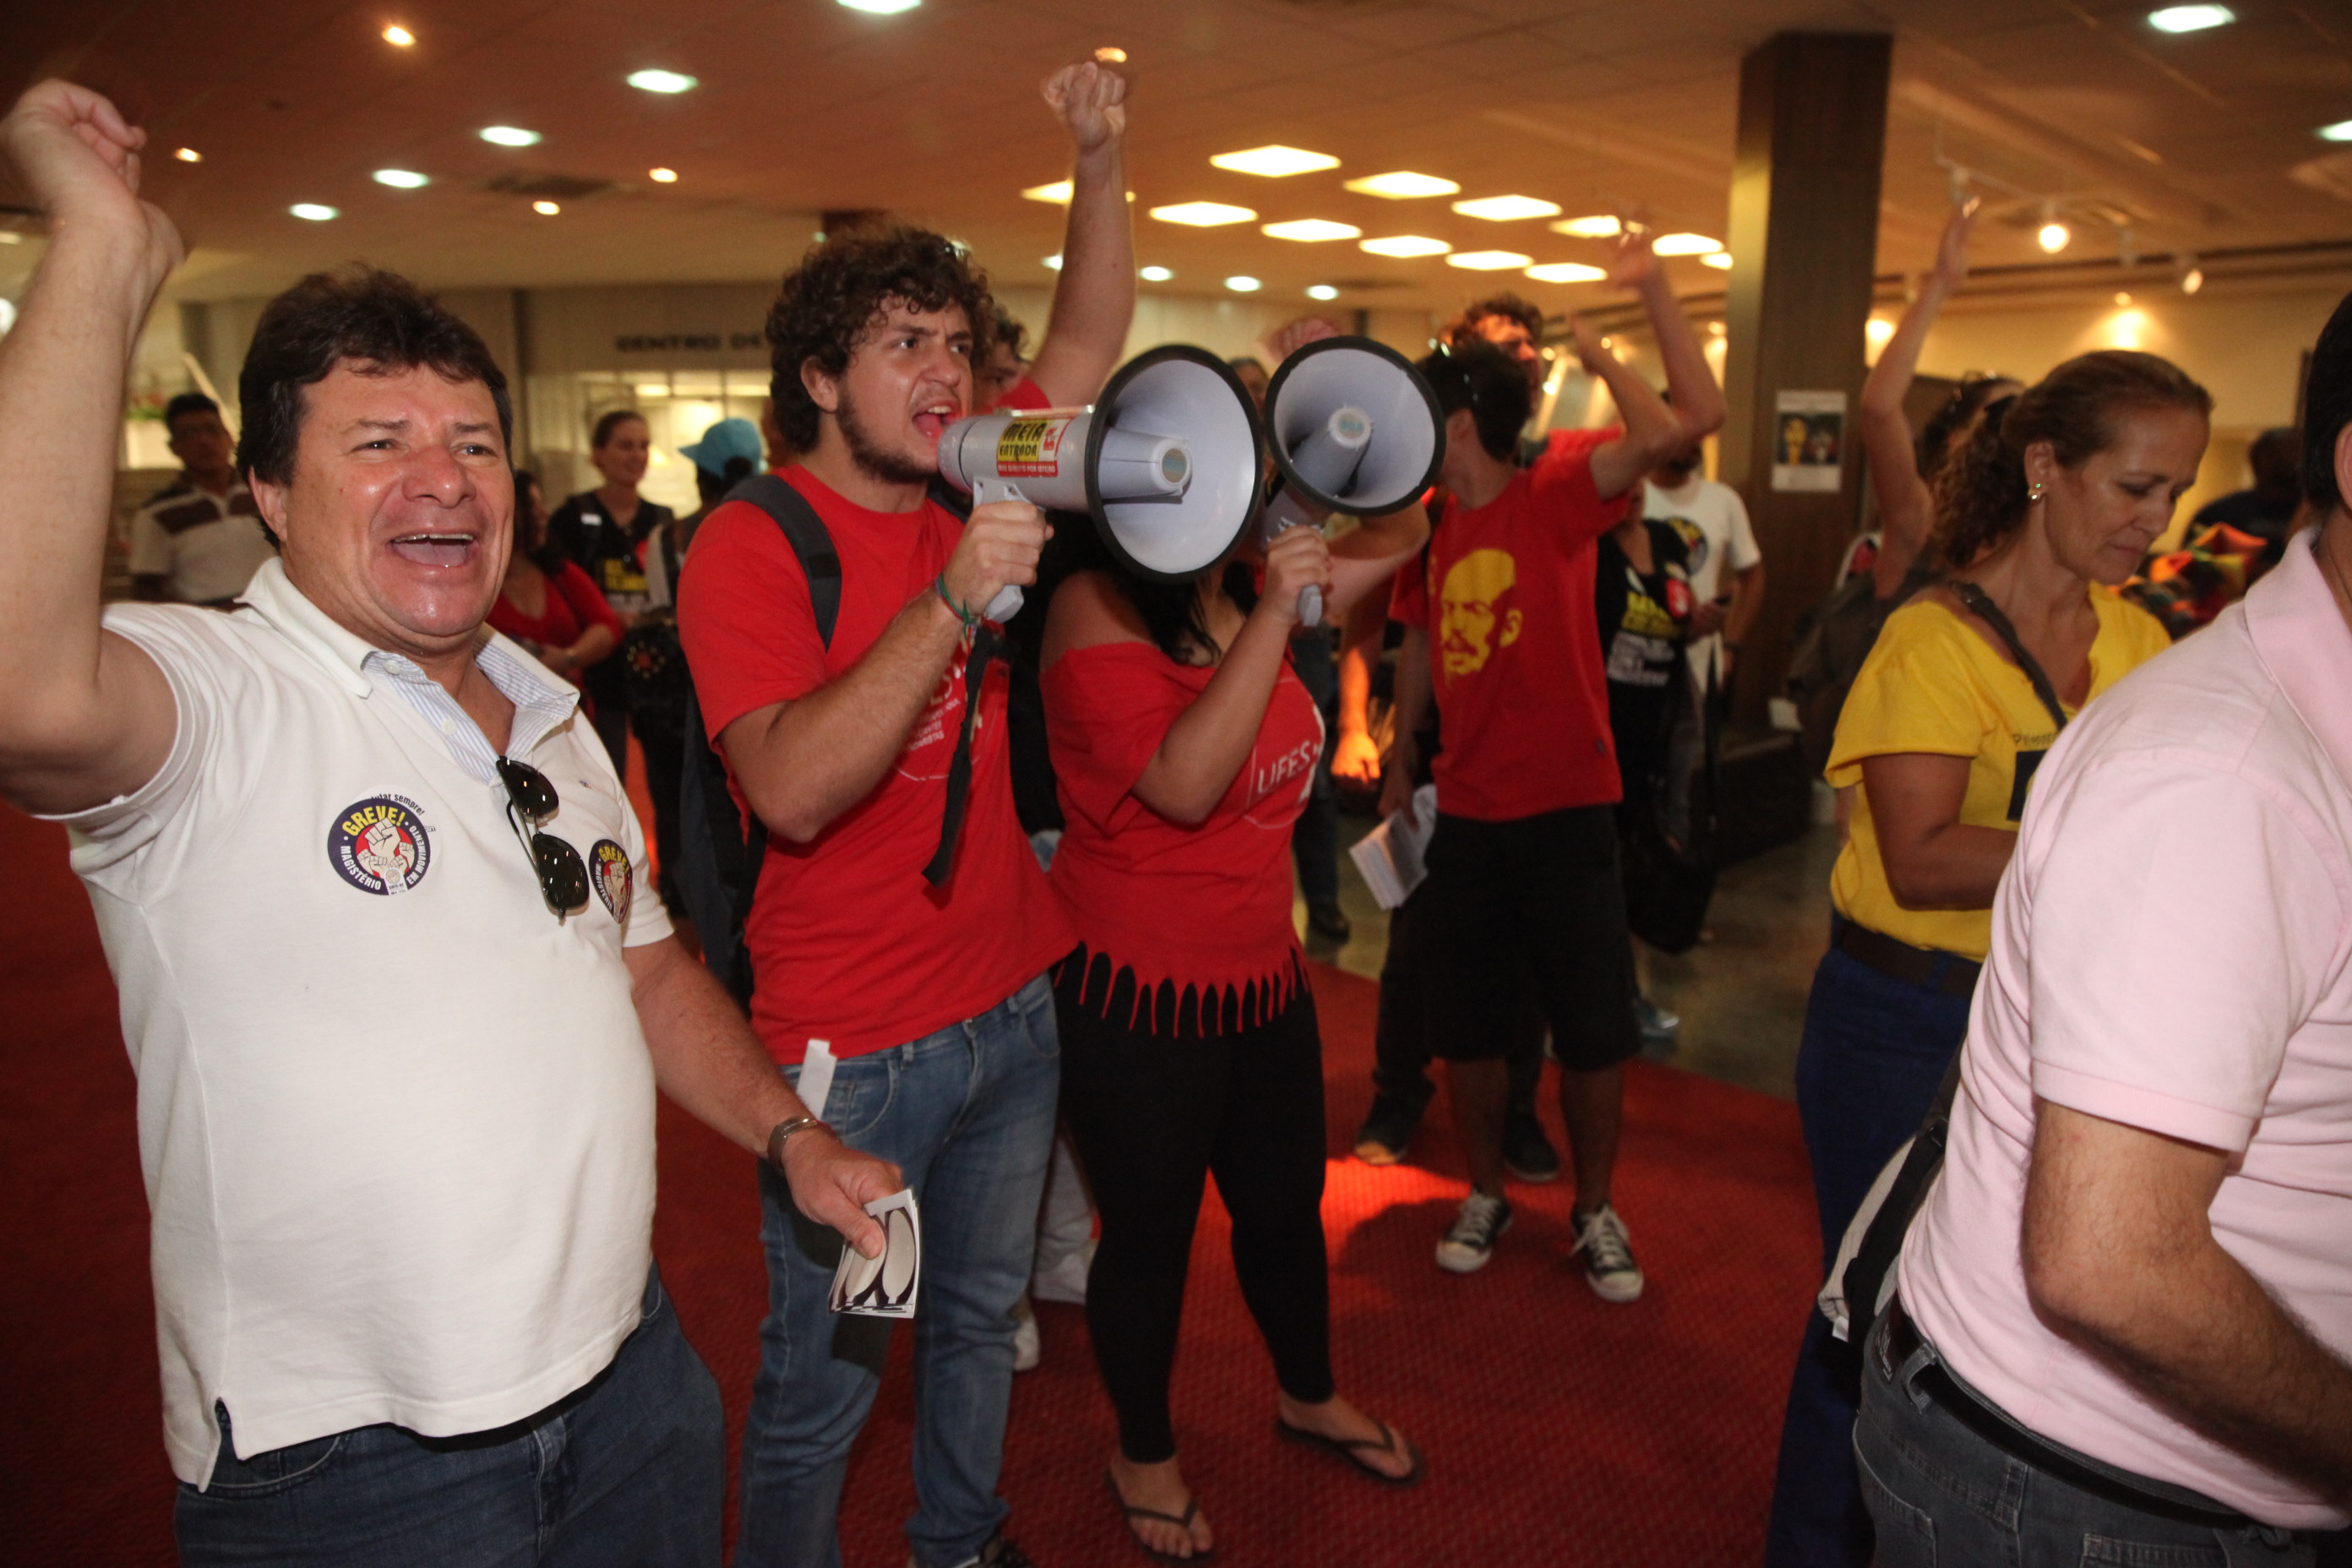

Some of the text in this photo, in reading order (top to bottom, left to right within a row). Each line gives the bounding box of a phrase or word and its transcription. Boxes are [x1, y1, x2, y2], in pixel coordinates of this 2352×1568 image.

[1003, 422, 1047, 441] MEIA
[999, 444, 1037, 456] ENTRADA
[395, 794, 425, 815] sempre!
[342, 805, 406, 836] GREVE!
[340, 846, 382, 890] MAGISTÉRIO
[406, 825, 427, 885] EM MOVIMENTO
